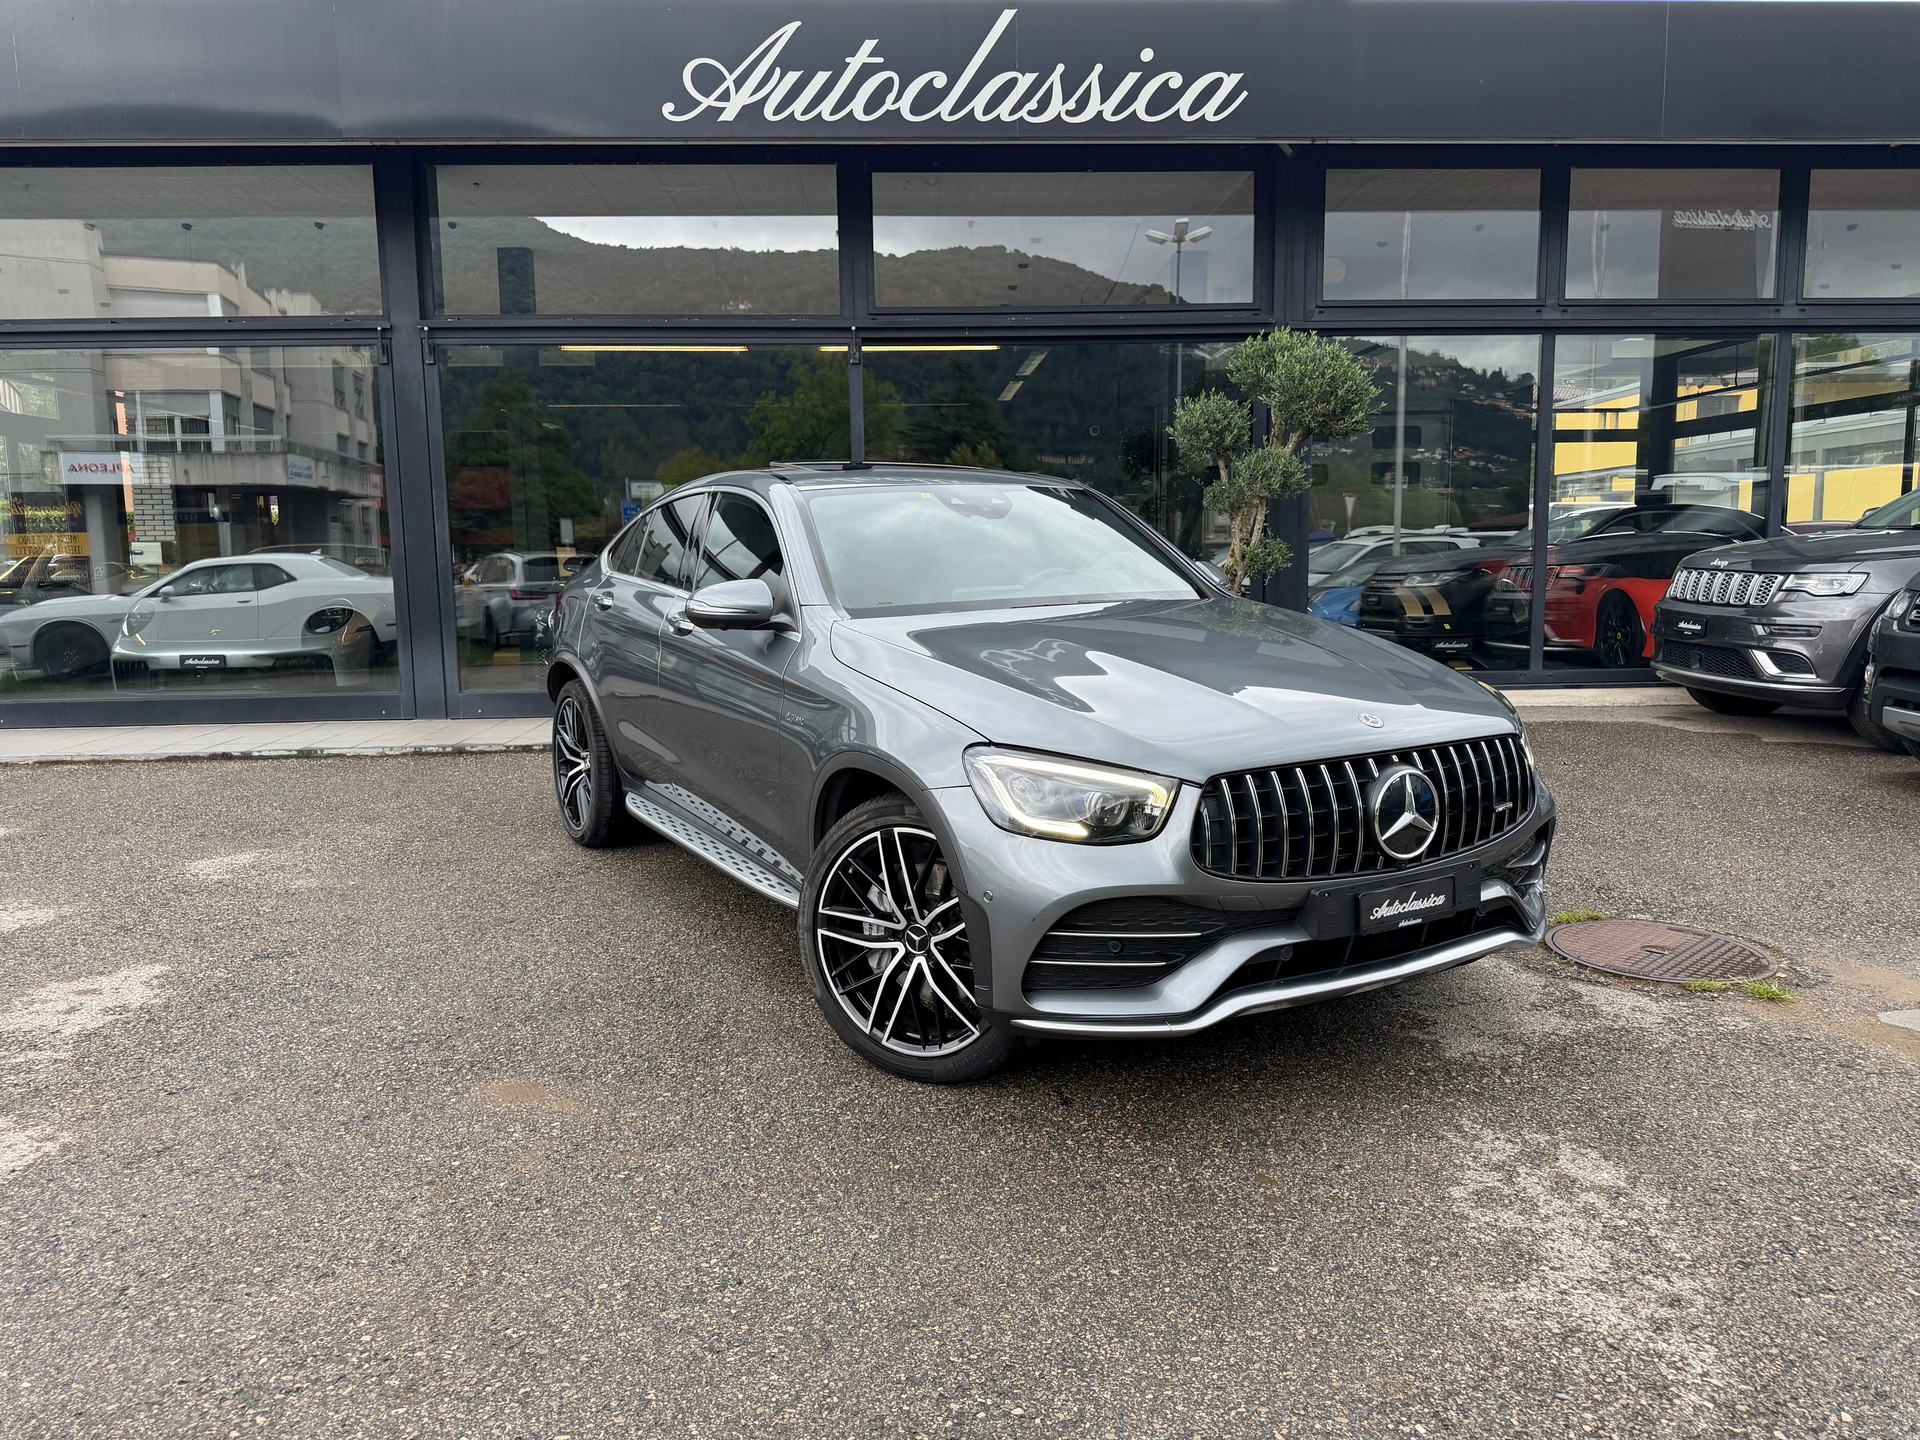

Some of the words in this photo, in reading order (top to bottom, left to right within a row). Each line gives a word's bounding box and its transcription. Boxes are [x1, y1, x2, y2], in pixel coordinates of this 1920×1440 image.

[662, 8, 1249, 123] Autoclassica
[1710, 558, 1729, 569] Jeep
[1370, 891, 1446, 920] Autoclassica
